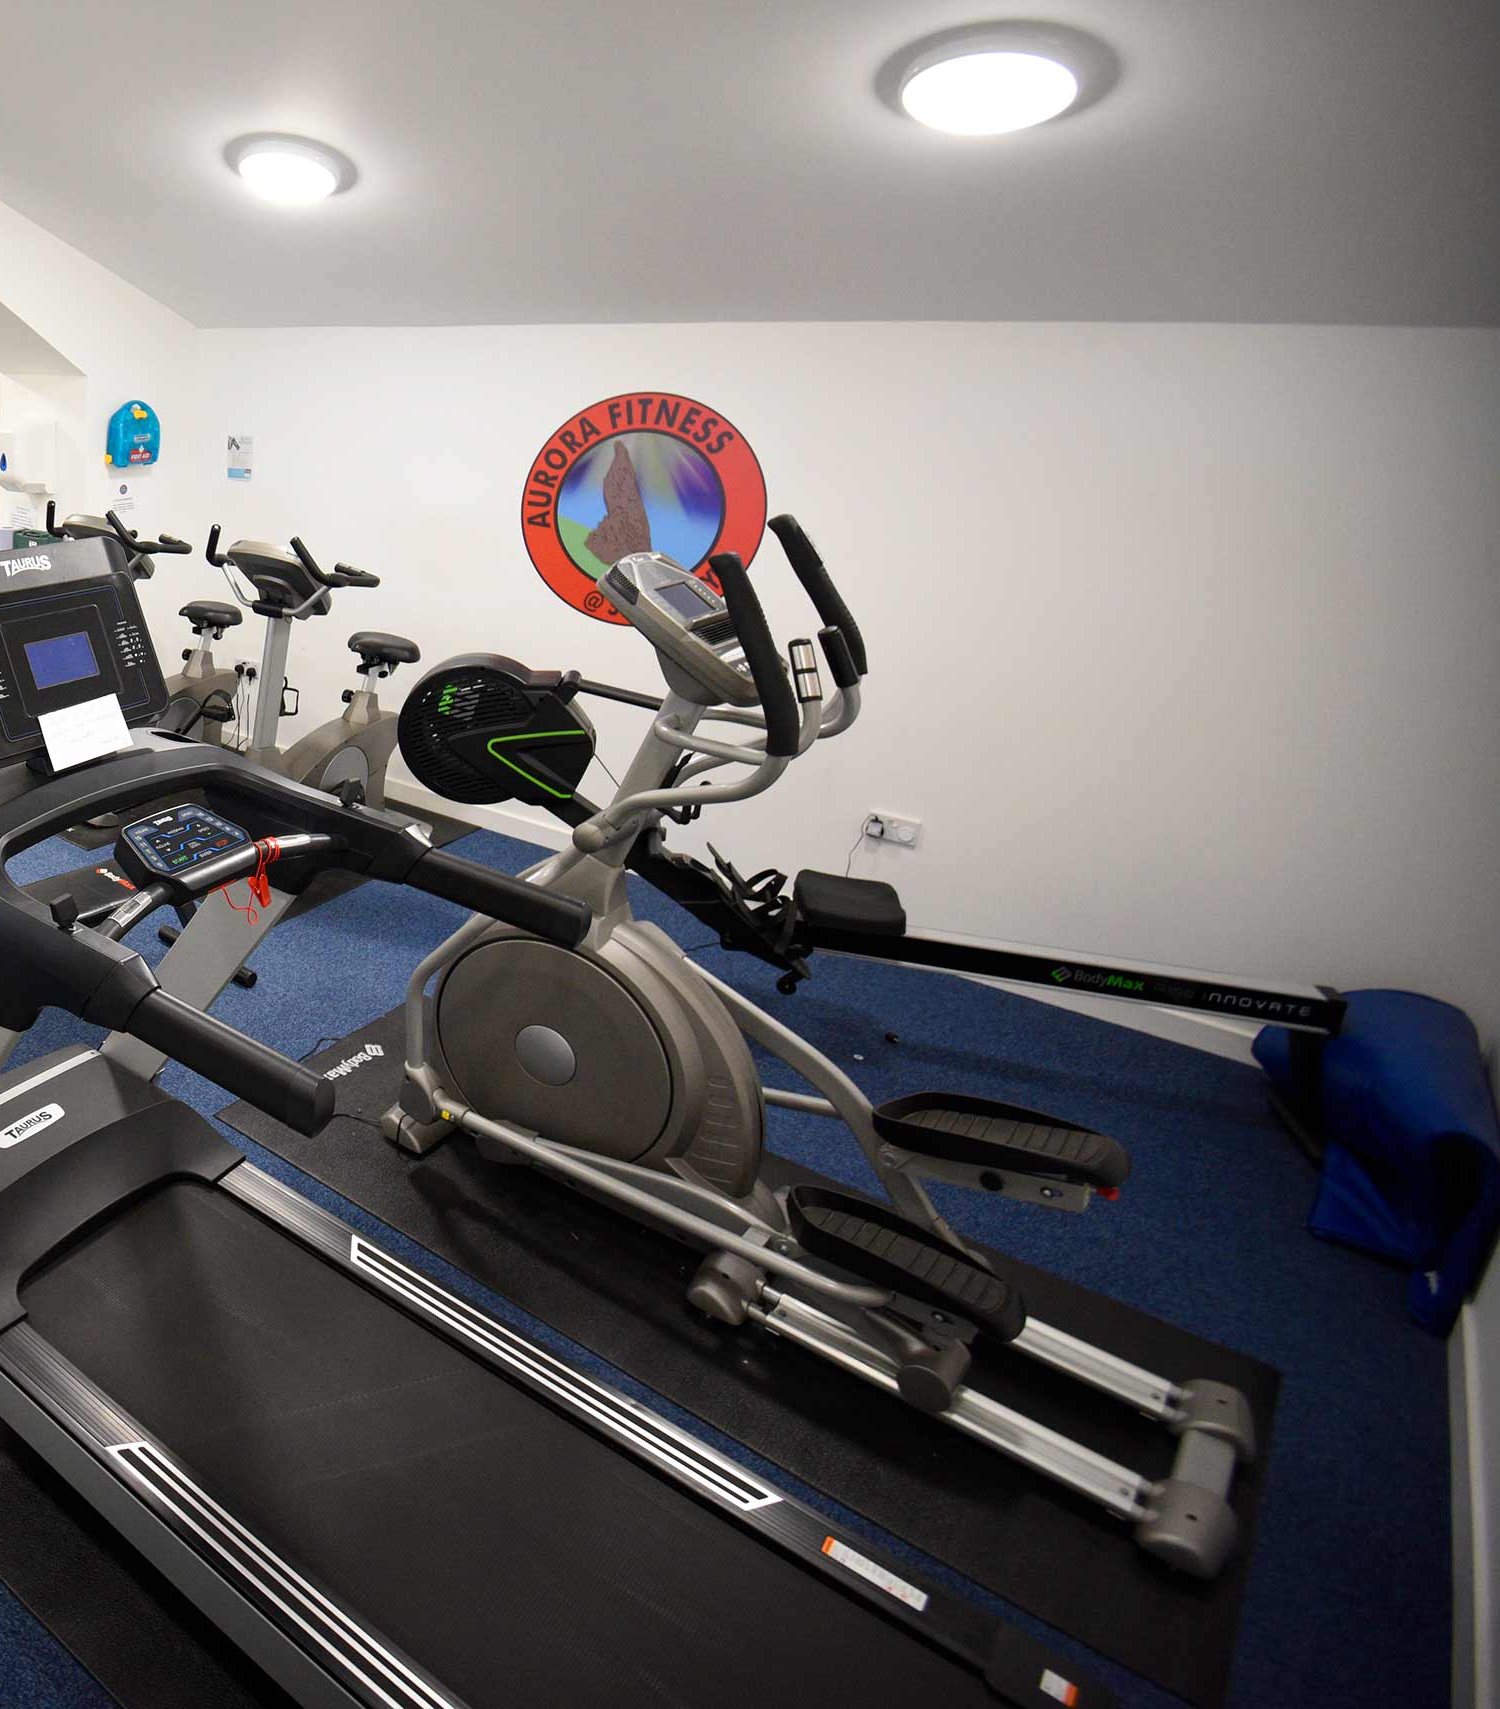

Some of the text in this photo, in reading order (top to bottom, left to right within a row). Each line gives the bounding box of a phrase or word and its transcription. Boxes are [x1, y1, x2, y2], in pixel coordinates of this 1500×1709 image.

[528, 398, 735, 529] AURORA FITNESS
[0, 554, 52, 577] TAURUS
[1074, 970, 1145, 991] BodyMax
[4, 1111, 53, 1139] TAURUS
